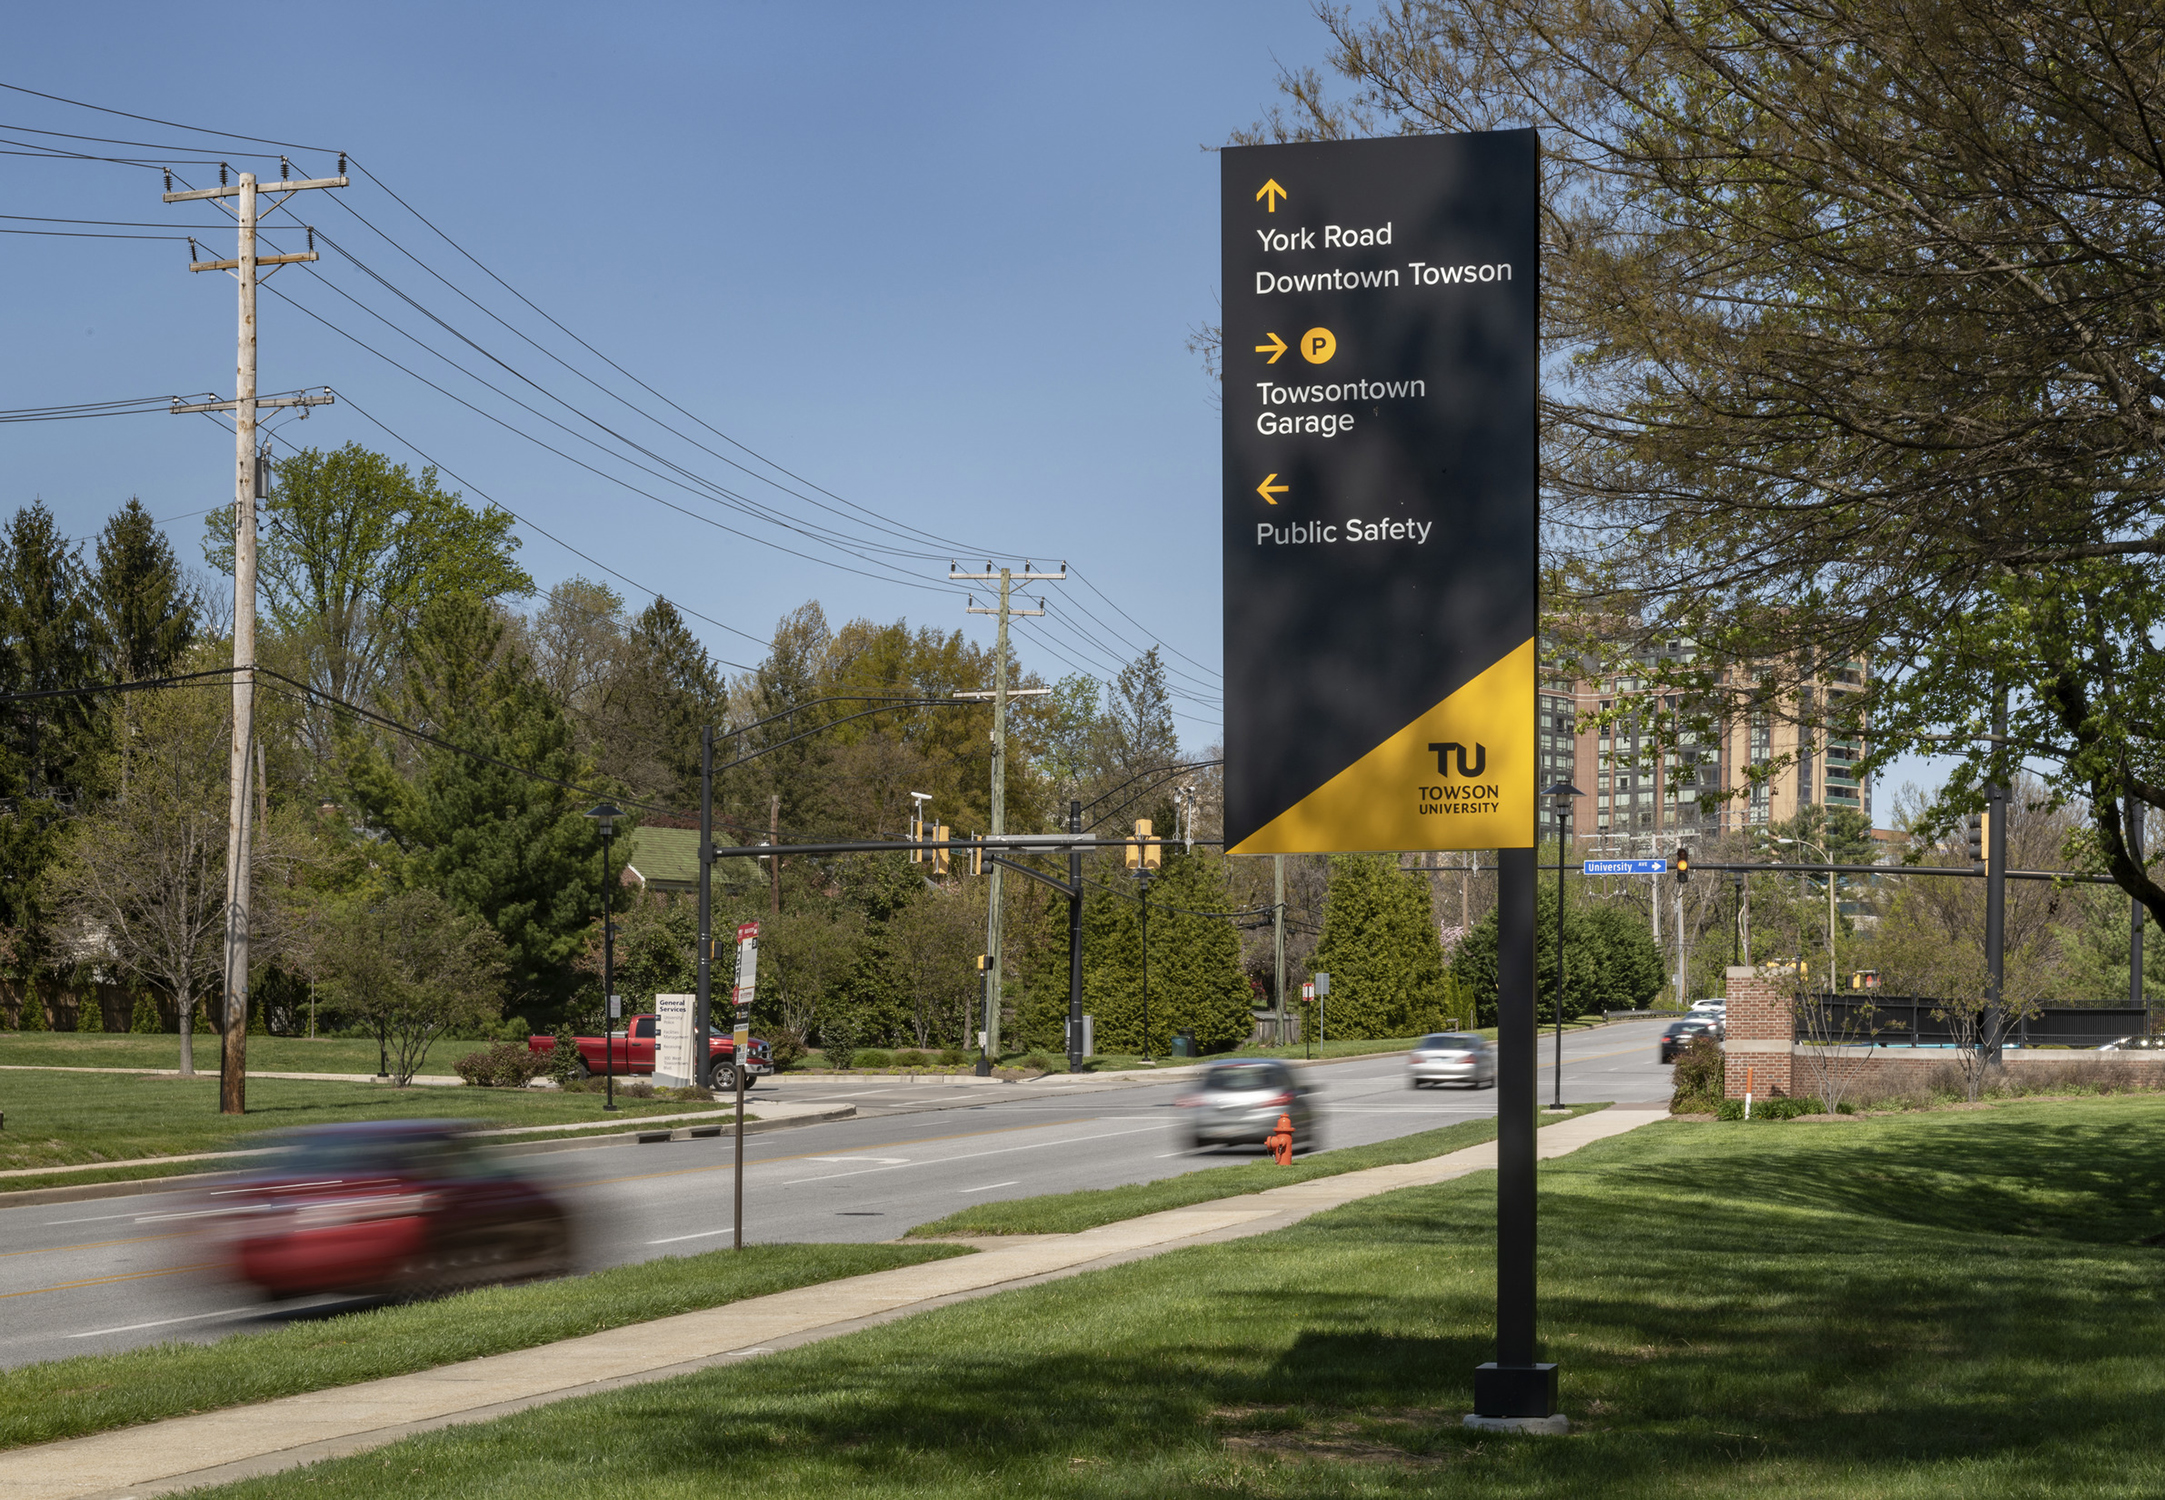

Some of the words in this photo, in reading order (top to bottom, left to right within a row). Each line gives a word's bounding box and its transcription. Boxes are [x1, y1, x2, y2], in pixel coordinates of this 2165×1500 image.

[1256, 227, 1316, 252] York
[1324, 222, 1392, 249] Road
[1256, 268, 1399, 295] Downtown
[1408, 262, 1513, 286] Towson
[1312, 338, 1326, 355] P
[1256, 378, 1426, 406] Towsontown
[1256, 411, 1355, 438] Garage
[1256, 519, 1338, 546] Public
[1345, 516, 1433, 544] Safety
[1428, 741, 1486, 778] TU
[1418, 785, 1499, 801] TOWSON
[1419, 802, 1500, 815] UNIVERSITY
[1588, 862, 1633, 873] University
